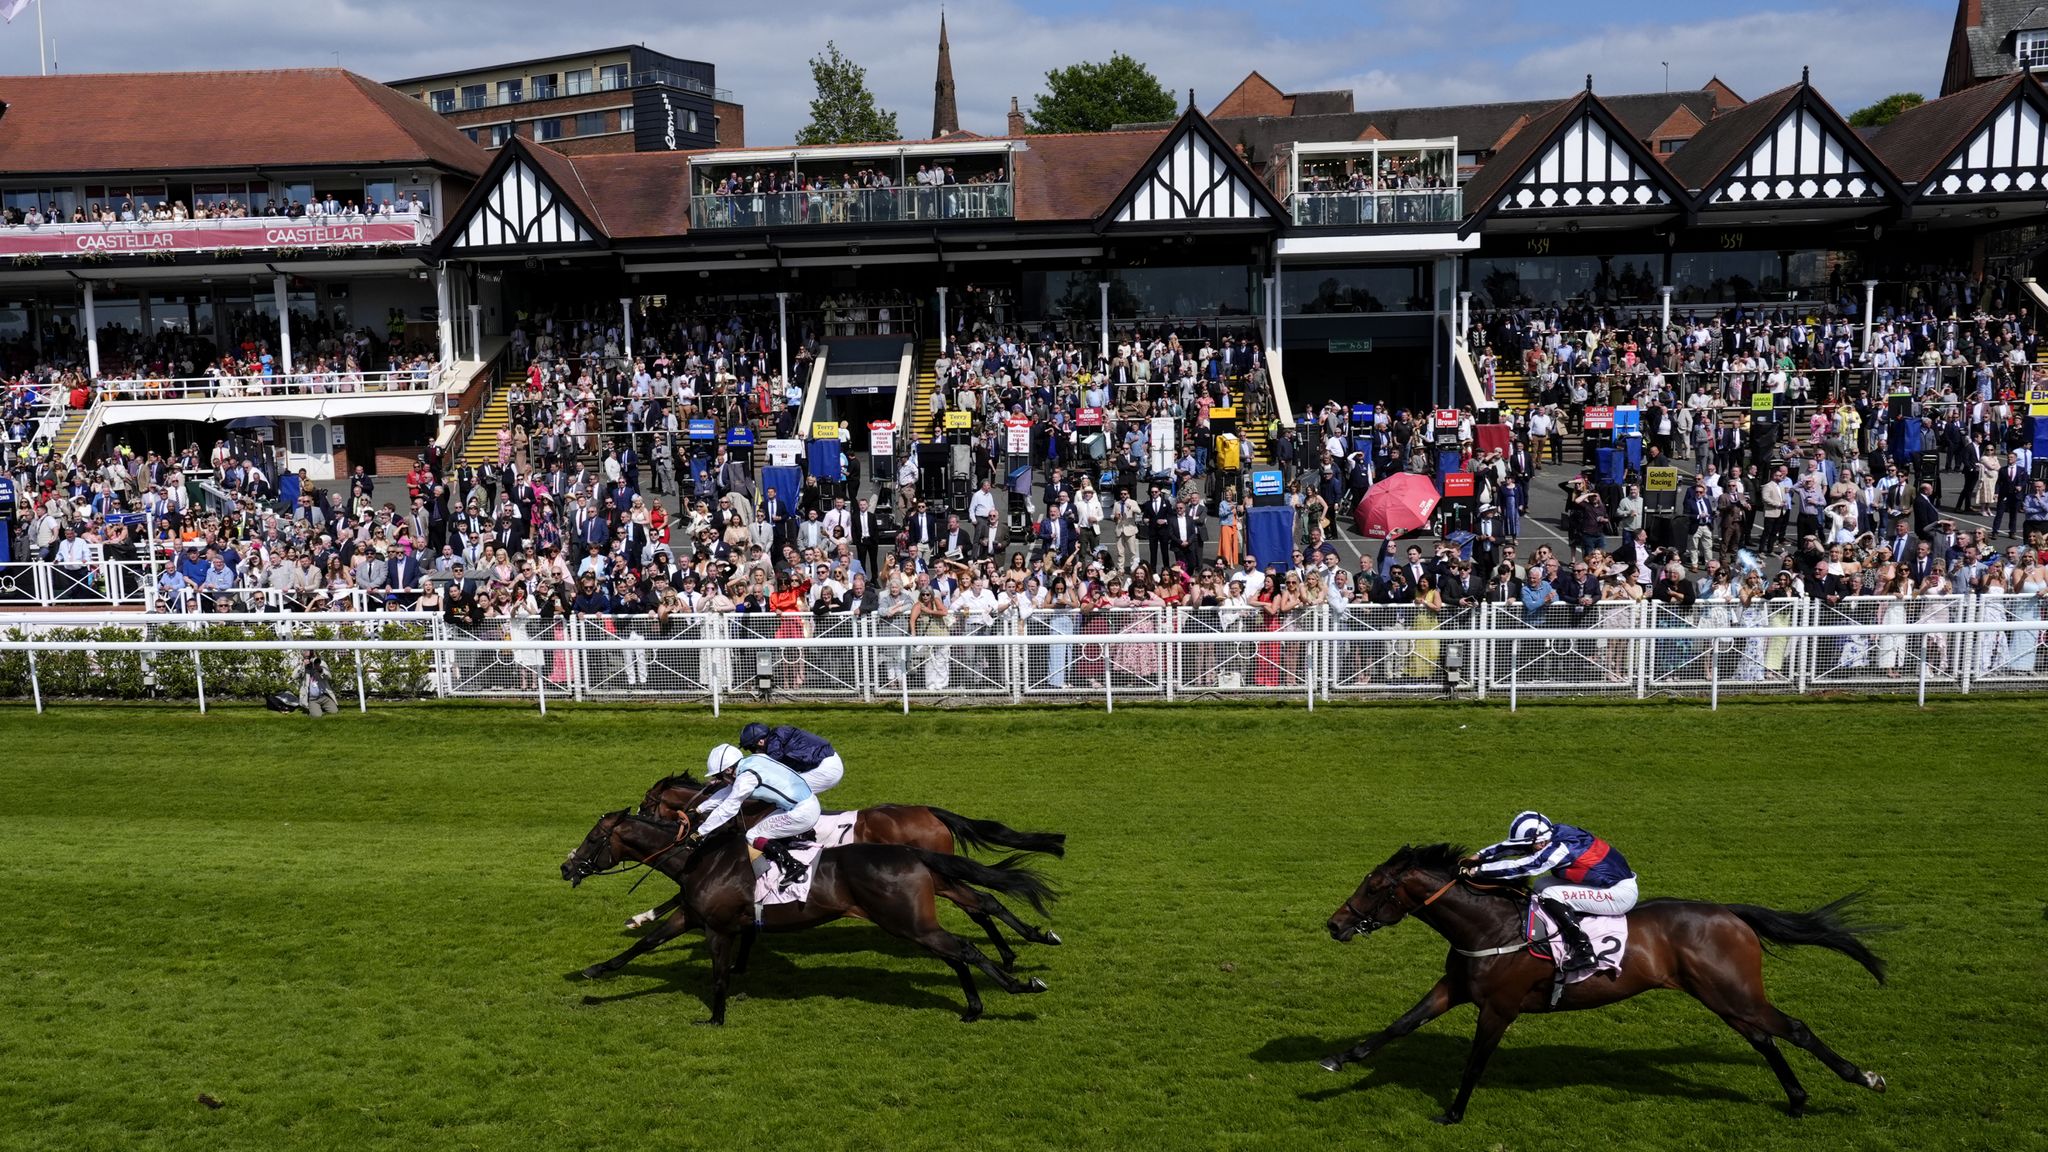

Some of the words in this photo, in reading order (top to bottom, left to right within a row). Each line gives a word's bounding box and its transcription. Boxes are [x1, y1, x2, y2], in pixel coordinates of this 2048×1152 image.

[76, 233, 174, 249] CAASTELLAR
[267, 227, 364, 244] CAASTELLAR
[1437, 418, 1456, 426] Brown
[1650, 479, 1672, 487] Racing
[837, 823, 853, 844] 7
[1596, 935, 1622, 964] 2
